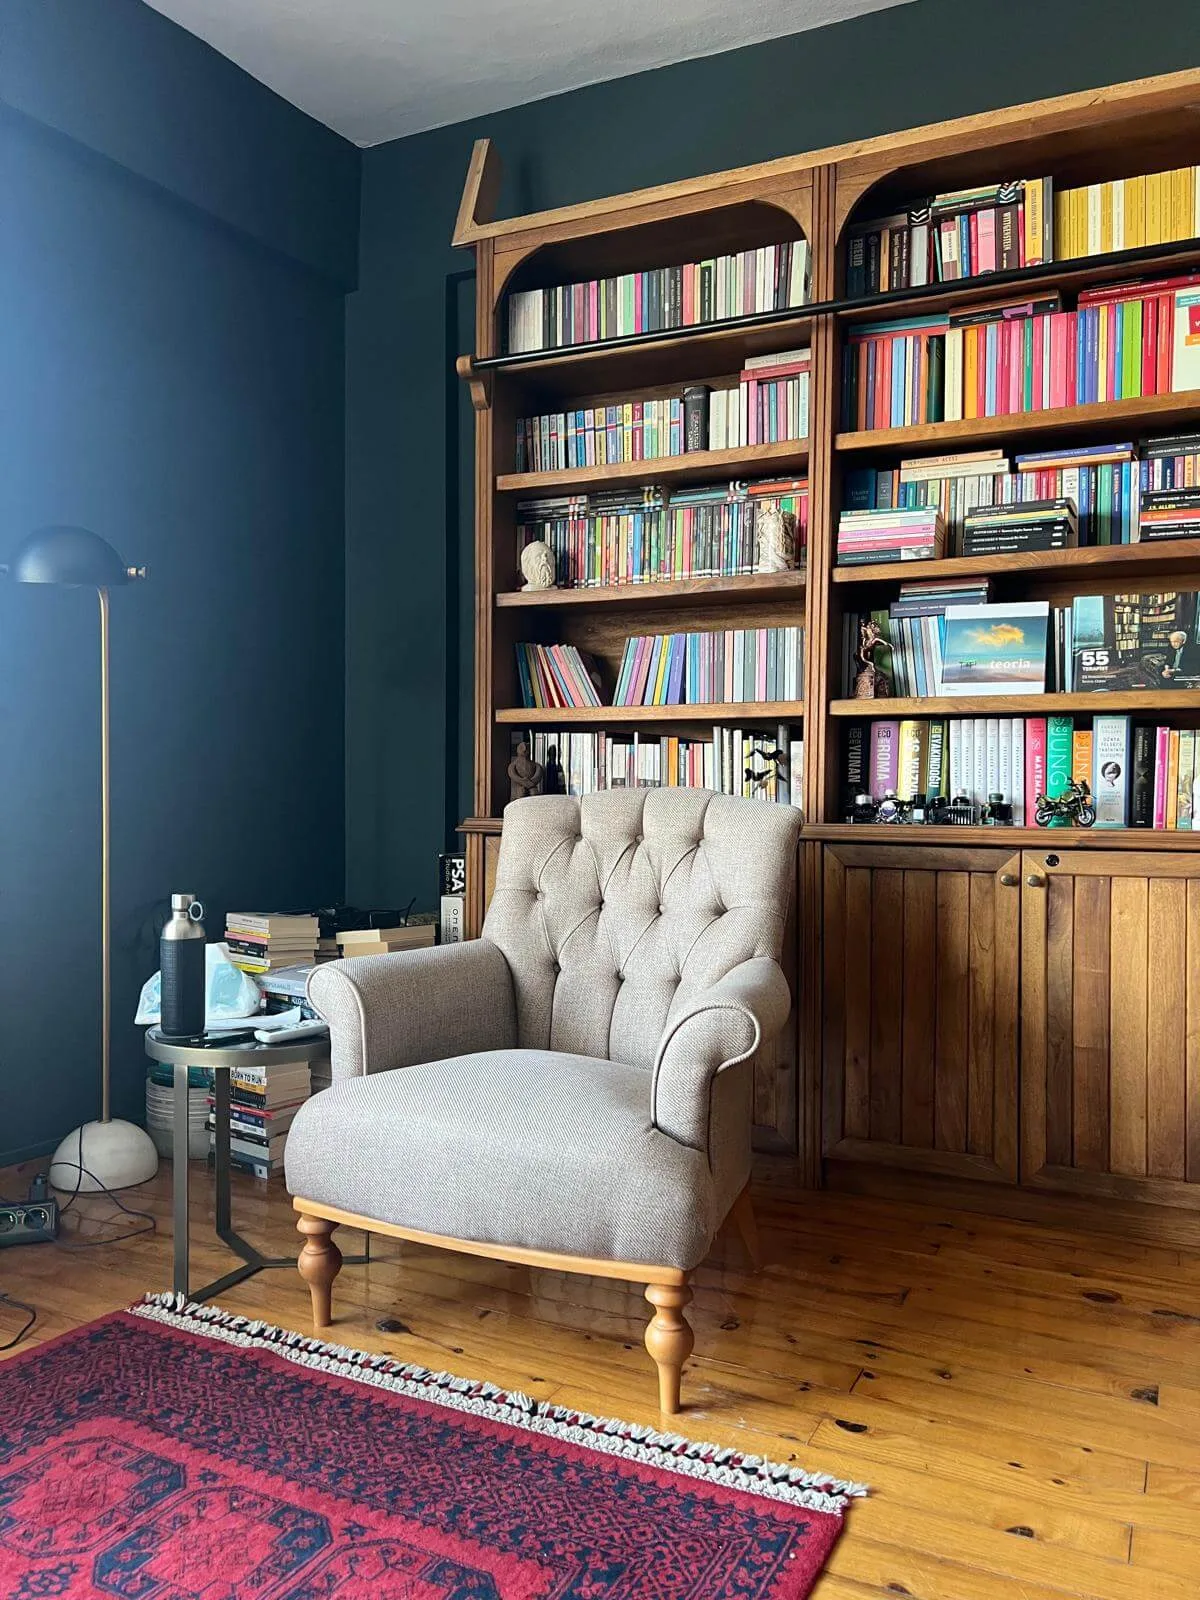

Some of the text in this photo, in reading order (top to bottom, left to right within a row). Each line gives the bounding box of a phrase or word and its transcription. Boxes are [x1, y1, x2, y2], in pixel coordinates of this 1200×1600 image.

[1001, 211, 1012, 251] WITTGENSTEIN
[853, 238, 863, 267] FREUD
[990, 658, 1031, 669] teoria
[1081, 650, 1110, 666] 55
[848, 744, 862, 783] YUNAN
[876, 744, 891, 781] ROMA
[1050, 728, 1067, 786] JUNG
[451, 858, 465, 892] PSA
[230, 1070, 262, 1086] BORN TO RUN
